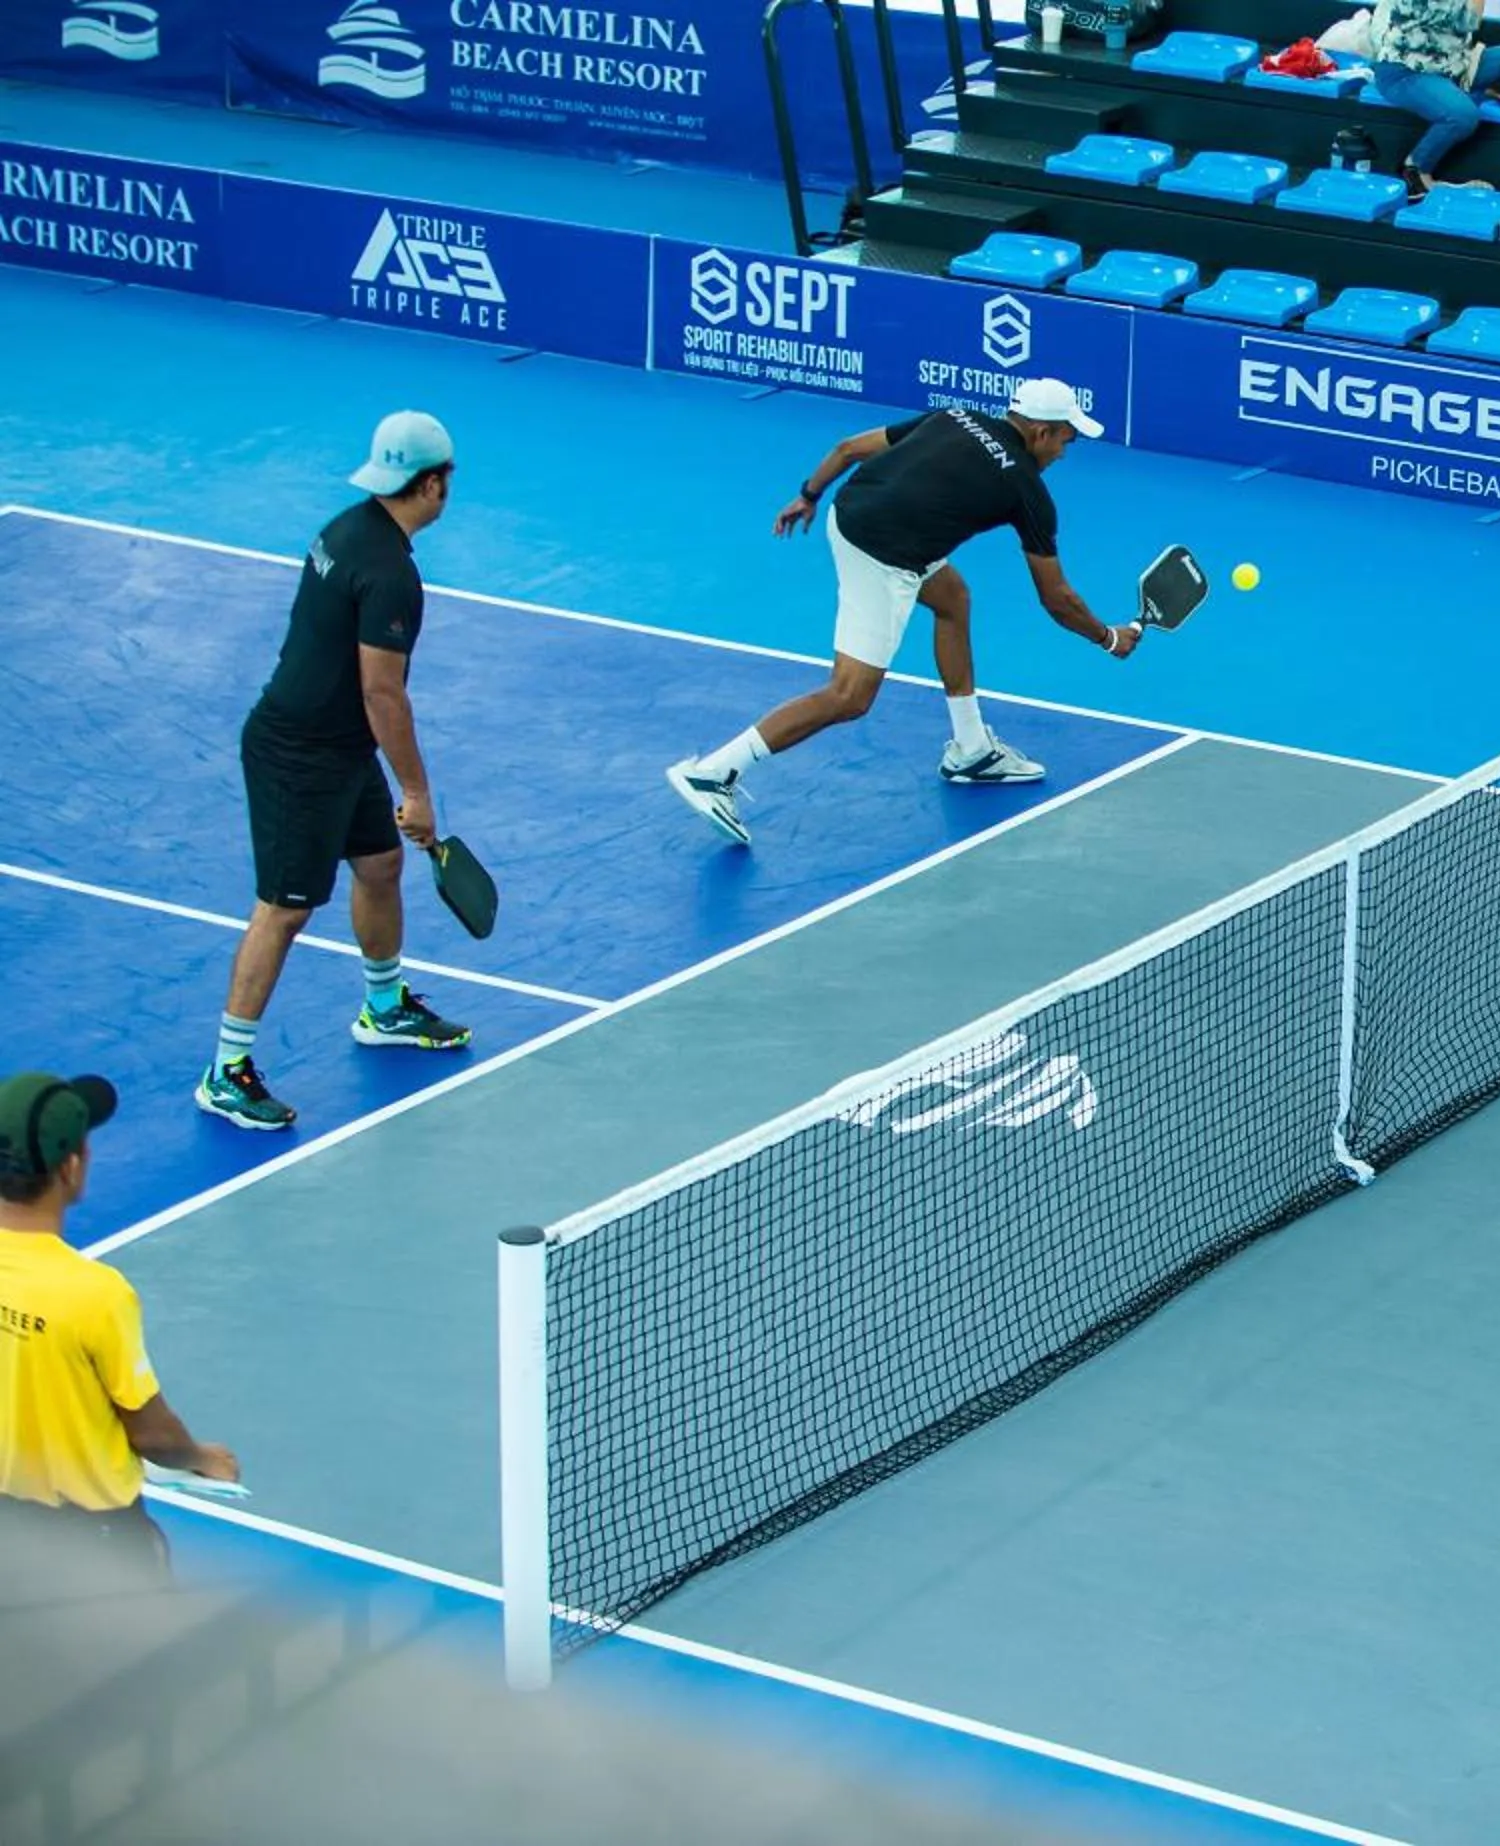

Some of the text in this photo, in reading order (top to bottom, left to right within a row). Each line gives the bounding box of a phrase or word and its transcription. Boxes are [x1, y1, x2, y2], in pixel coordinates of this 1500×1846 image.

[451, 0, 705, 55] CARMELINA
[452, 39, 707, 97] BEACH RESORT
[0, 160, 195, 224] RMELINA
[67, 223, 198, 271] RESORT
[397, 213, 487, 249] TRIPLE
[351, 285, 507, 331] TRIPLE ACE
[745, 261, 857, 339] SEPT
[684, 324, 863, 375] SPORT REHABILITATION
[919, 359, 959, 391] SEPT
[962, 366, 1024, 398] STREN
